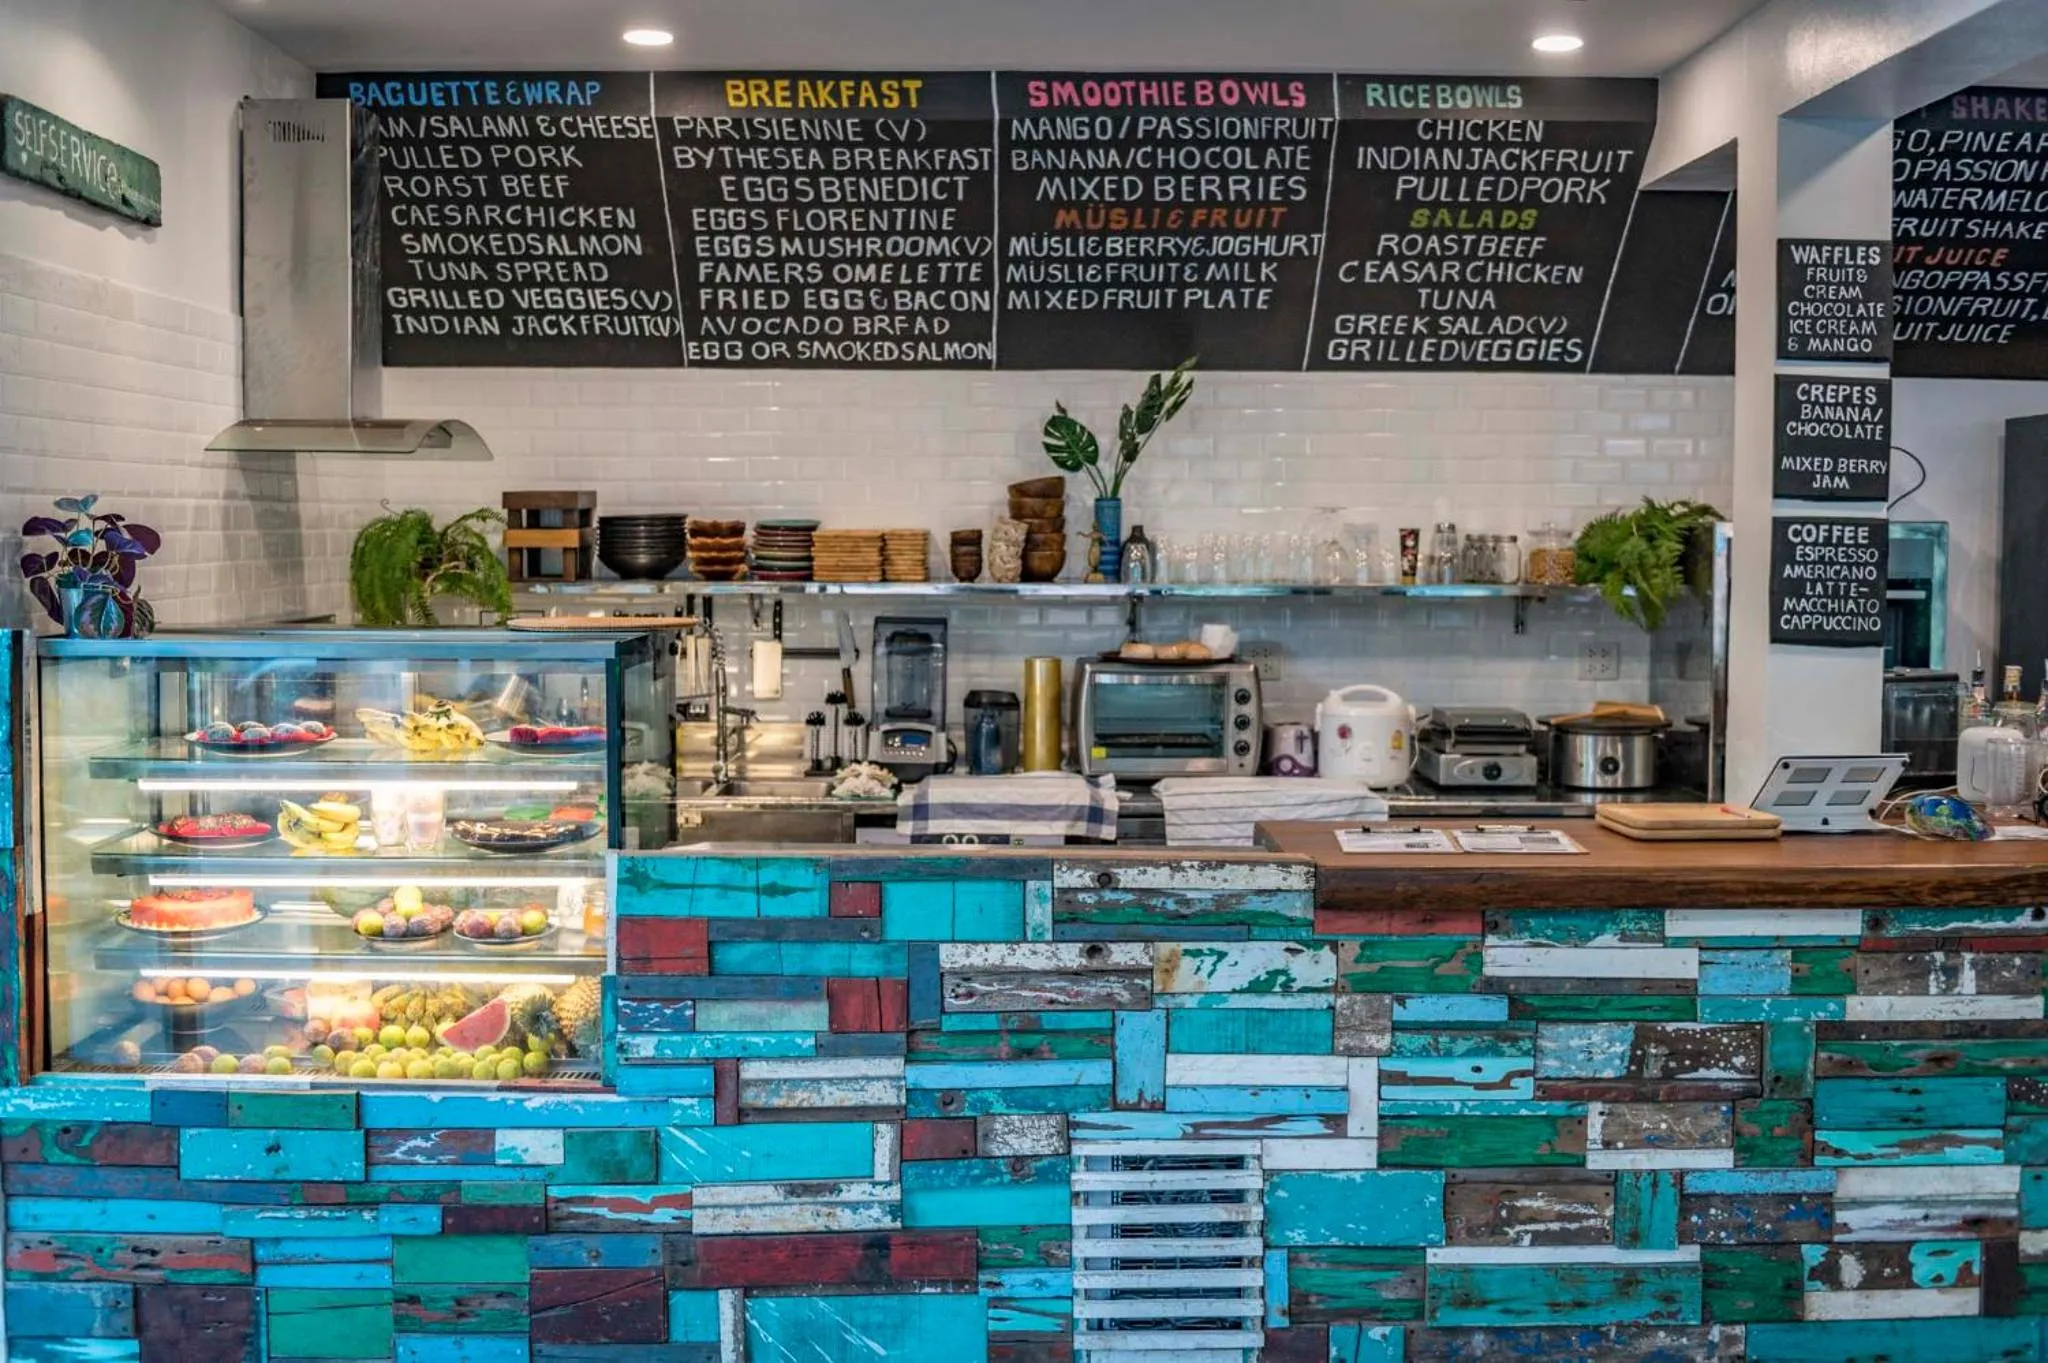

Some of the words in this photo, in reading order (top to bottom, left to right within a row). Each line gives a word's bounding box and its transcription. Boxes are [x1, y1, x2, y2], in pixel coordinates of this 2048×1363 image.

[725, 79, 923, 109] BREAKFAST
[1027, 79, 1187, 108] SMOOTHIE
[1194, 79, 1308, 108] BOWLS
[672, 115, 864, 142] PARISIENNE
[875, 118, 926, 142] (V)
[1416, 118, 1546, 144] CHICKEN
[489, 145, 584, 169] PORK
[832, 148, 992, 171] BREAKFAST
[383, 174, 488, 198] ROAST
[500, 175, 570, 198] BEEF
[1035, 176, 1144, 201] MIXED
[1153, 176, 1308, 202] BERRIES
[691, 208, 769, 231] EGGS
[775, 208, 957, 231] FLORENTINE
[1409, 207, 1539, 231] SALADS
[1790, 244, 1881, 266] WAFFLES
[407, 259, 489, 283] TUNA
[495, 262, 609, 283] SPREAD
[698, 262, 824, 284] FAMERS
[832, 263, 983, 284] OMELETTE
[386, 287, 504, 310] GRILLED
[699, 288, 791, 311] FRIED
[1417, 288, 1497, 311] TUNA
[1803, 284, 1863, 300] CREAM
[1787, 301, 1886, 318] CHOCOLATE
[392, 314, 501, 336] INDIAN
[700, 315, 844, 337] AVOCADO
[1334, 314, 1430, 336] GREEK
[1789, 318, 1813, 335] ICE
[1815, 319, 1878, 336] CREAM
[687, 341, 744, 361] EGG
[751, 342, 791, 360] OR
[1787, 336, 1799, 352] &
[1806, 336, 1873, 353] MANGO
[1796, 382, 1878, 406] CREPES
[1800, 403, 1884, 423] BANANA/
[1786, 420, 1885, 441] CHOCOLATE
[1781, 455, 1833, 472] MIXED
[1836, 458, 1888, 475] BERRY
[1812, 473, 1851, 489] JAM
[1787, 523, 1870, 545] COFFEE
[1795, 545, 1880, 563] ESPRESSO
[1782, 563, 1878, 581] AMERICANO
[1782, 596, 1881, 615] MACCHIATO
[1779, 613, 1882, 631] CAPPUCCINO
